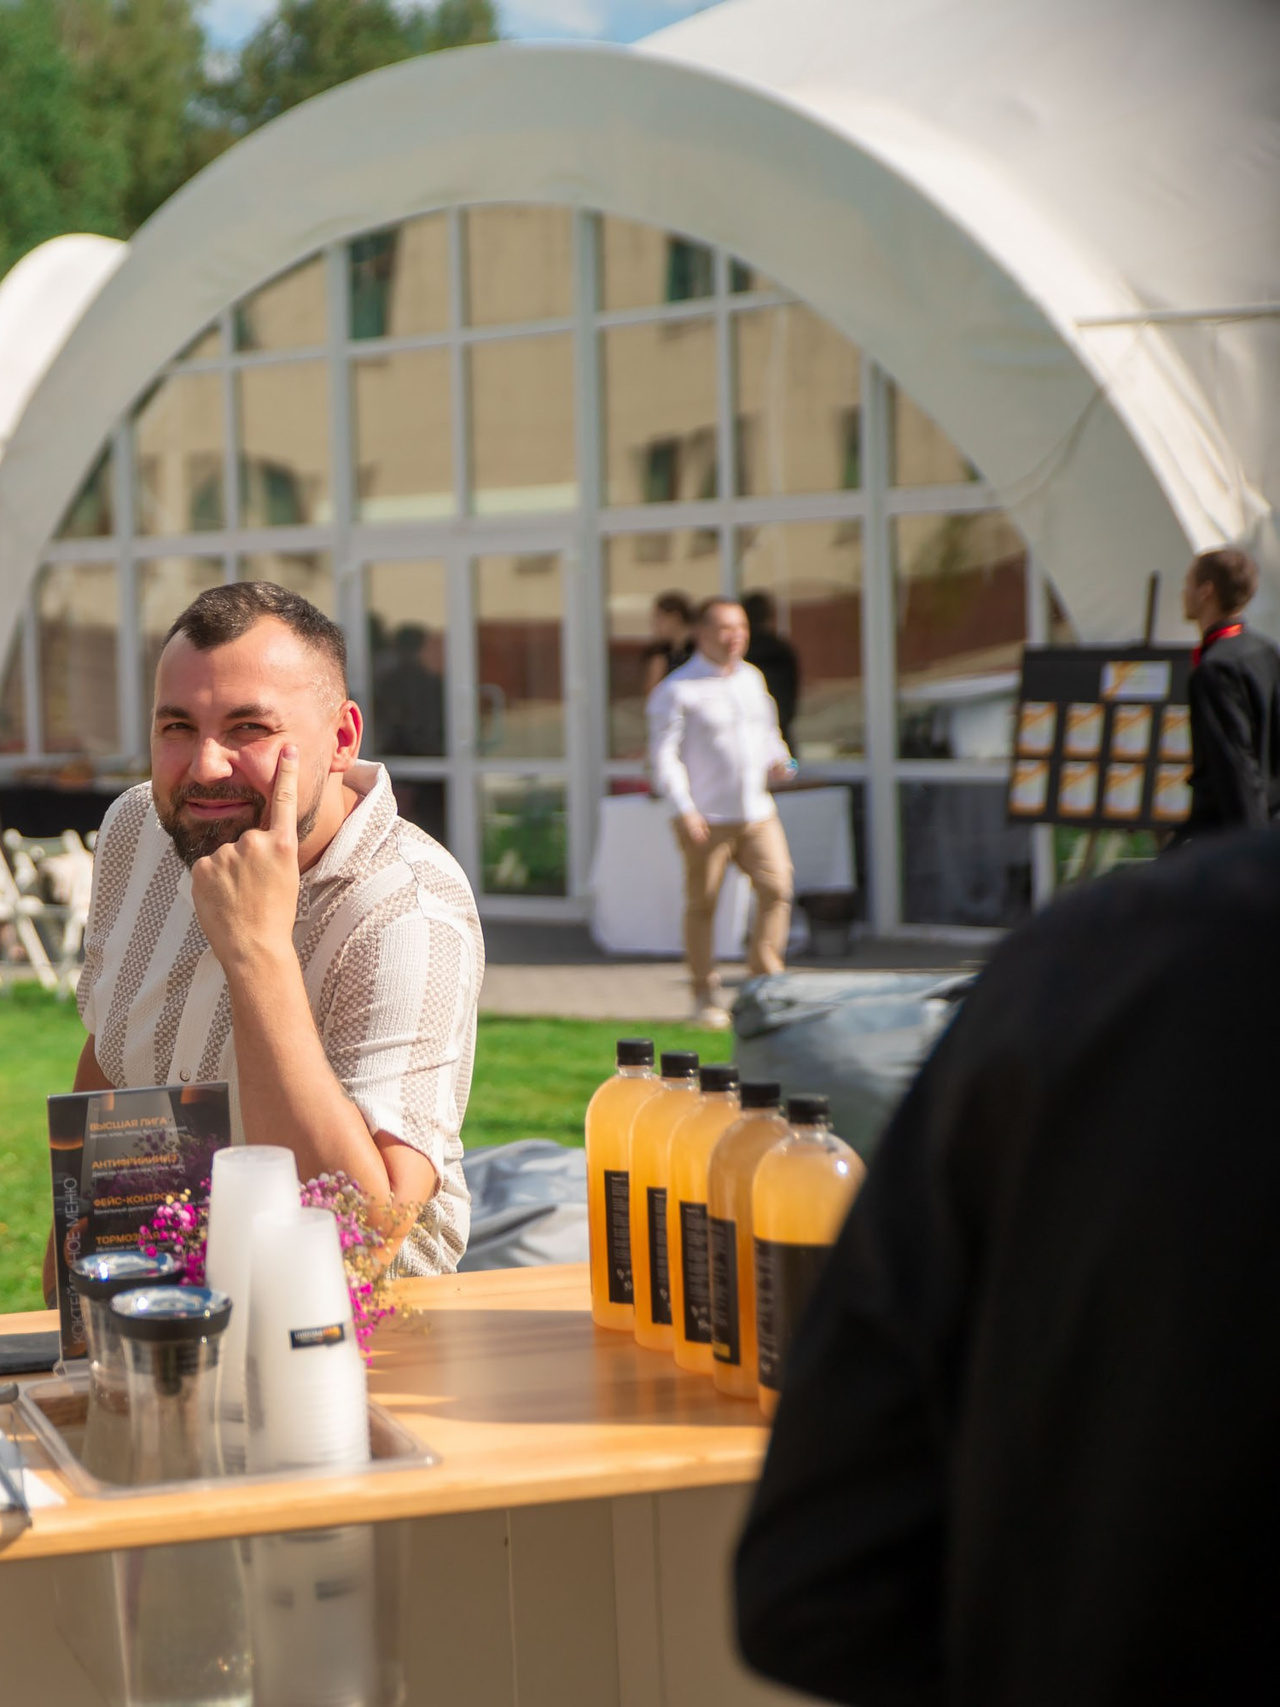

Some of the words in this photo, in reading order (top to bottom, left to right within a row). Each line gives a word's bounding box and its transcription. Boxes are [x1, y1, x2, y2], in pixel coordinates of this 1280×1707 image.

[89, 1119, 138, 1132] ВЫСШАЯ
[140, 1116, 167, 1126] ЛИГА
[63, 1177, 80, 1228] МЕНЮ
[66, 1231, 86, 1344] КОКТЕЙНОЕ
